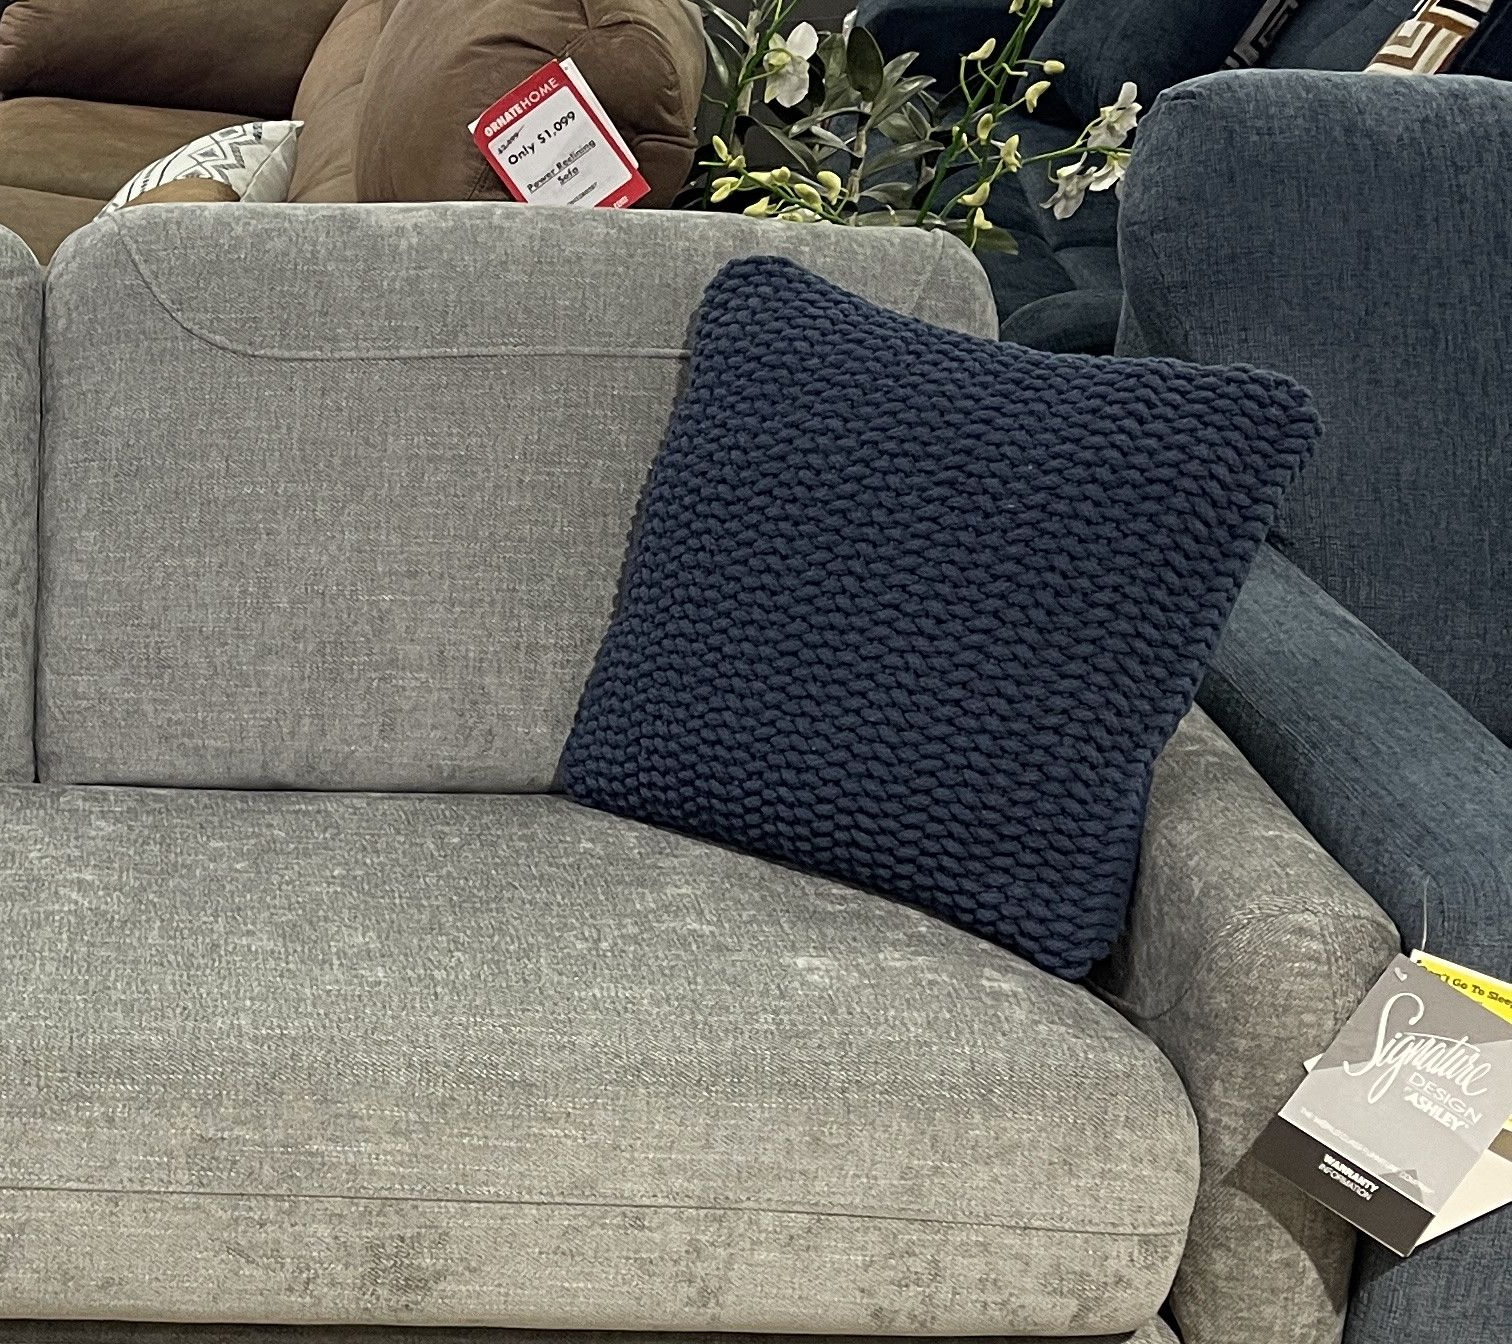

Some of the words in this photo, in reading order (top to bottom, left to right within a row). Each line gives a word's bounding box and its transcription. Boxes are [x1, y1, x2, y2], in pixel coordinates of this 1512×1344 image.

[508, 142, 535, 165] Only
[537, 110, 576, 144] $1,099
[526, 166, 557, 192] Power
[557, 166, 579, 185] Sofa
[1452, 978, 1468, 990] Go
[1472, 984, 1485, 996] To
[1487, 991, 1512, 1009] Slee
[1343, 992, 1492, 1104] Signature
[1408, 1071, 1483, 1124] DESIGN
[1318, 1162, 1373, 1201] INFORMATION
[1323, 1153, 1380, 1193] WARRANTY
